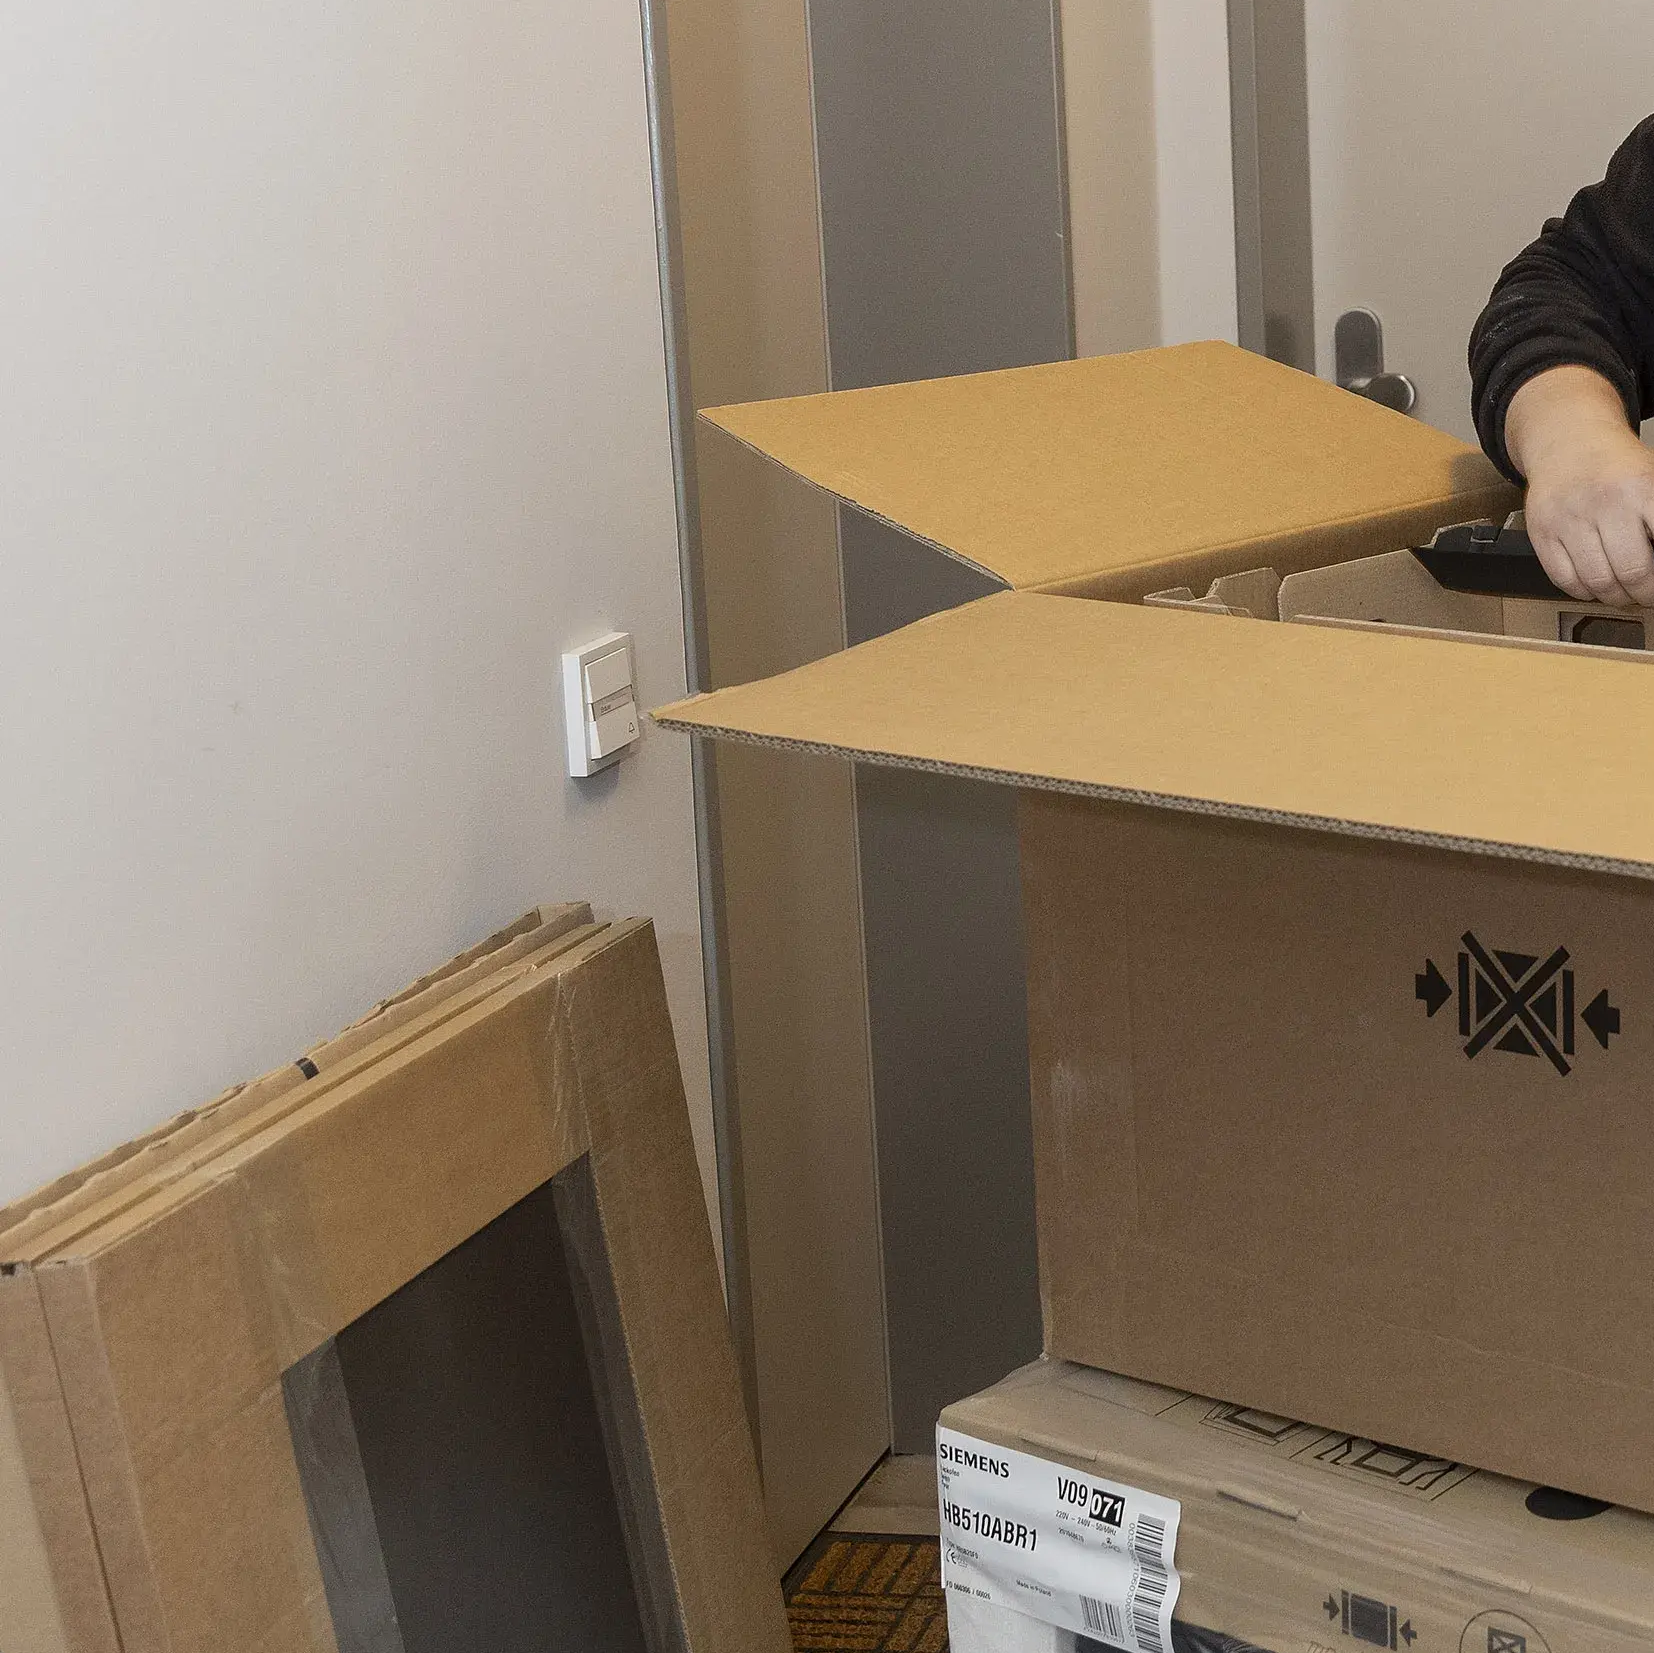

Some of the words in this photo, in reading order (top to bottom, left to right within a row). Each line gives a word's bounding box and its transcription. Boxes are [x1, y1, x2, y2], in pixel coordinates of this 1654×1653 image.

[940, 1443, 1010, 1478] SIEMENS
[1057, 1476, 1088, 1507] V09
[1090, 1492, 1124, 1524] 071
[943, 1498, 1038, 1552] HB510ABR1
